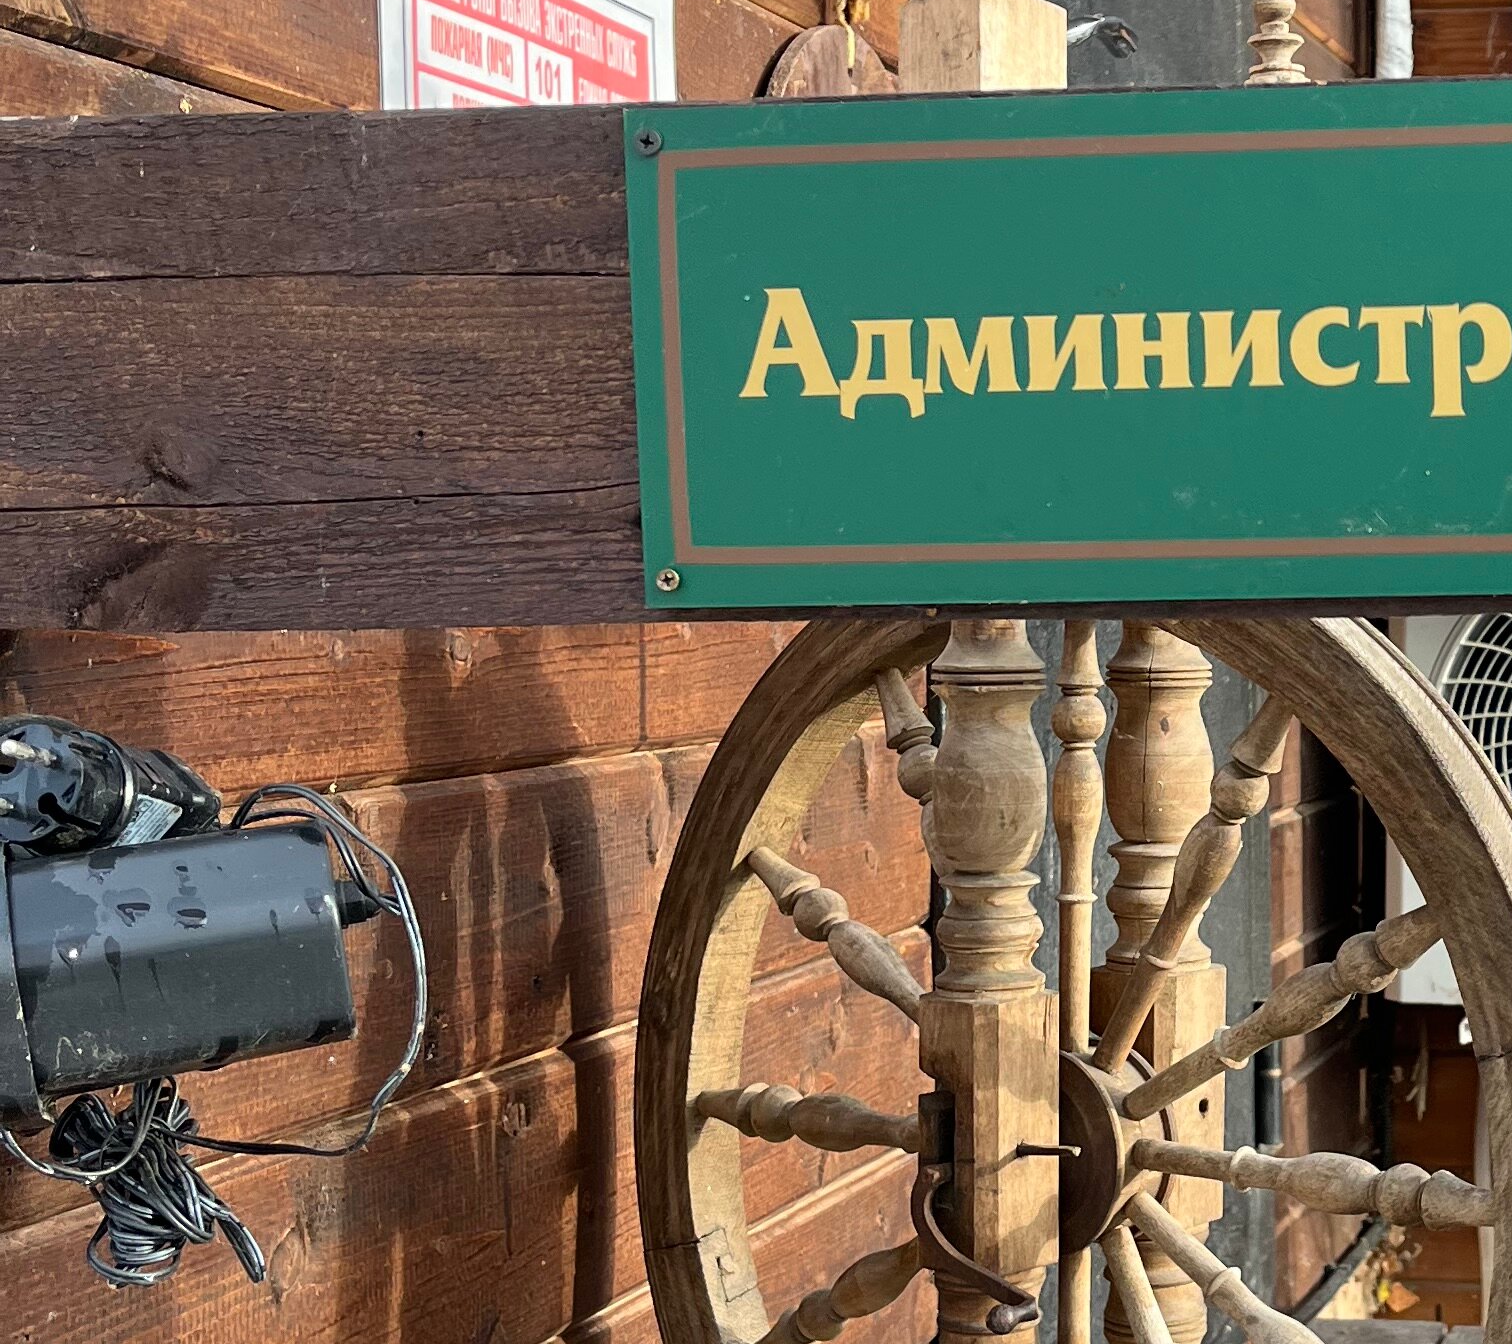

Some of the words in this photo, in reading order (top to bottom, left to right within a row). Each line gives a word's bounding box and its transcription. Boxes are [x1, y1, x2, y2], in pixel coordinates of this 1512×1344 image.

[431, 14, 483, 69] ПОЖАРНАЯ
[544, 0, 605, 64] ЭКСТРЕННЫХ
[606, 28, 637, 78] СЛУЖБ
[535, 55, 561, 102] 101
